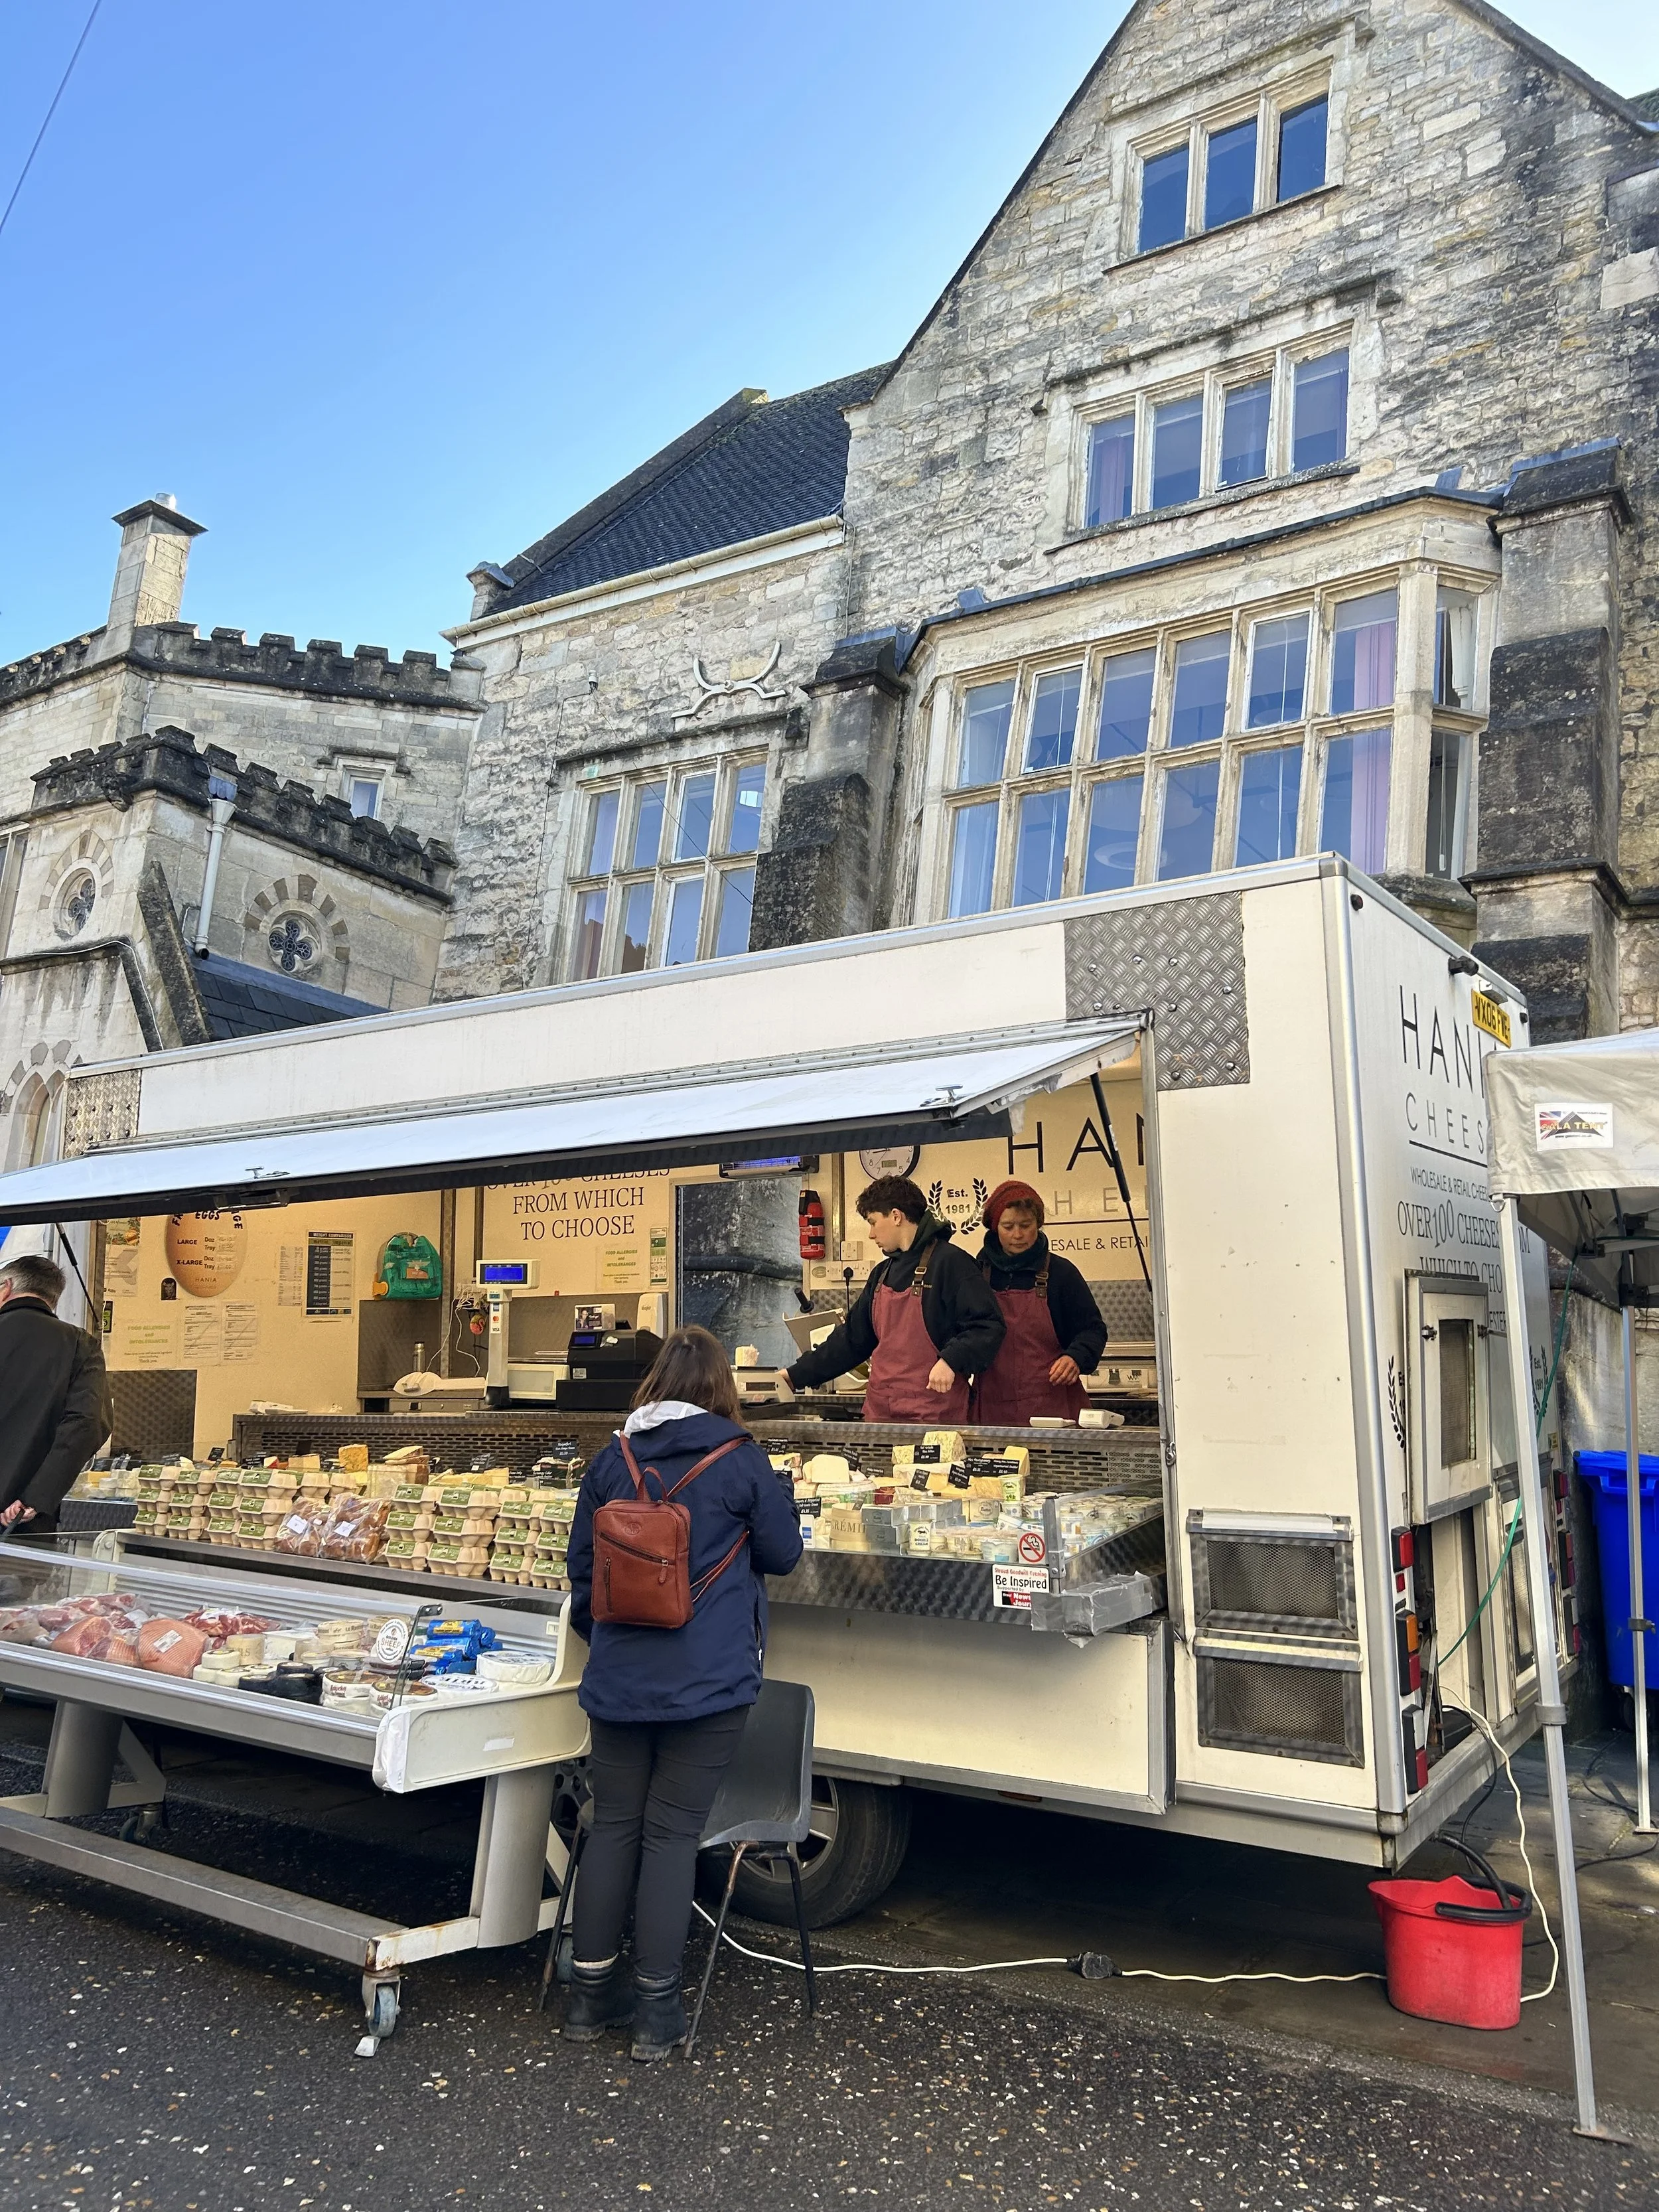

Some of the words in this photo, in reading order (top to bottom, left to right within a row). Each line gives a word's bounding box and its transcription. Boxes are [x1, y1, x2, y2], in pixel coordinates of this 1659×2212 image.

[1400, 985, 1497, 1098] HANI
[1540, 1122, 1571, 1131] GALA
[876, 1167, 881, 1175] 7
[1410, 1166, 1447, 1192] WHOLESALE
[1447, 1177, 1453, 1193] &
[1453, 1178, 1471, 1198] RETAIL
[946, 1188, 968, 1198] Est.
[513, 1192, 567, 1215] FROM
[573, 1187, 644, 1210] WHICH
[195, 1211, 221, 1220] EGGS
[945, 1204, 971, 1215] 1981
[521, 1220, 545, 1240] TO
[552, 1215, 634, 1238] CHOOSE
[1398, 1201, 1433, 1239] OVER
[1432, 1199, 1455, 1248] 100
[1096, 1238, 1106, 1250] &
[995, 1574, 1007, 1585] Be
[1010, 1576, 1046, 1589] Inspired
[381, 1637, 401, 1649] SHEEP
